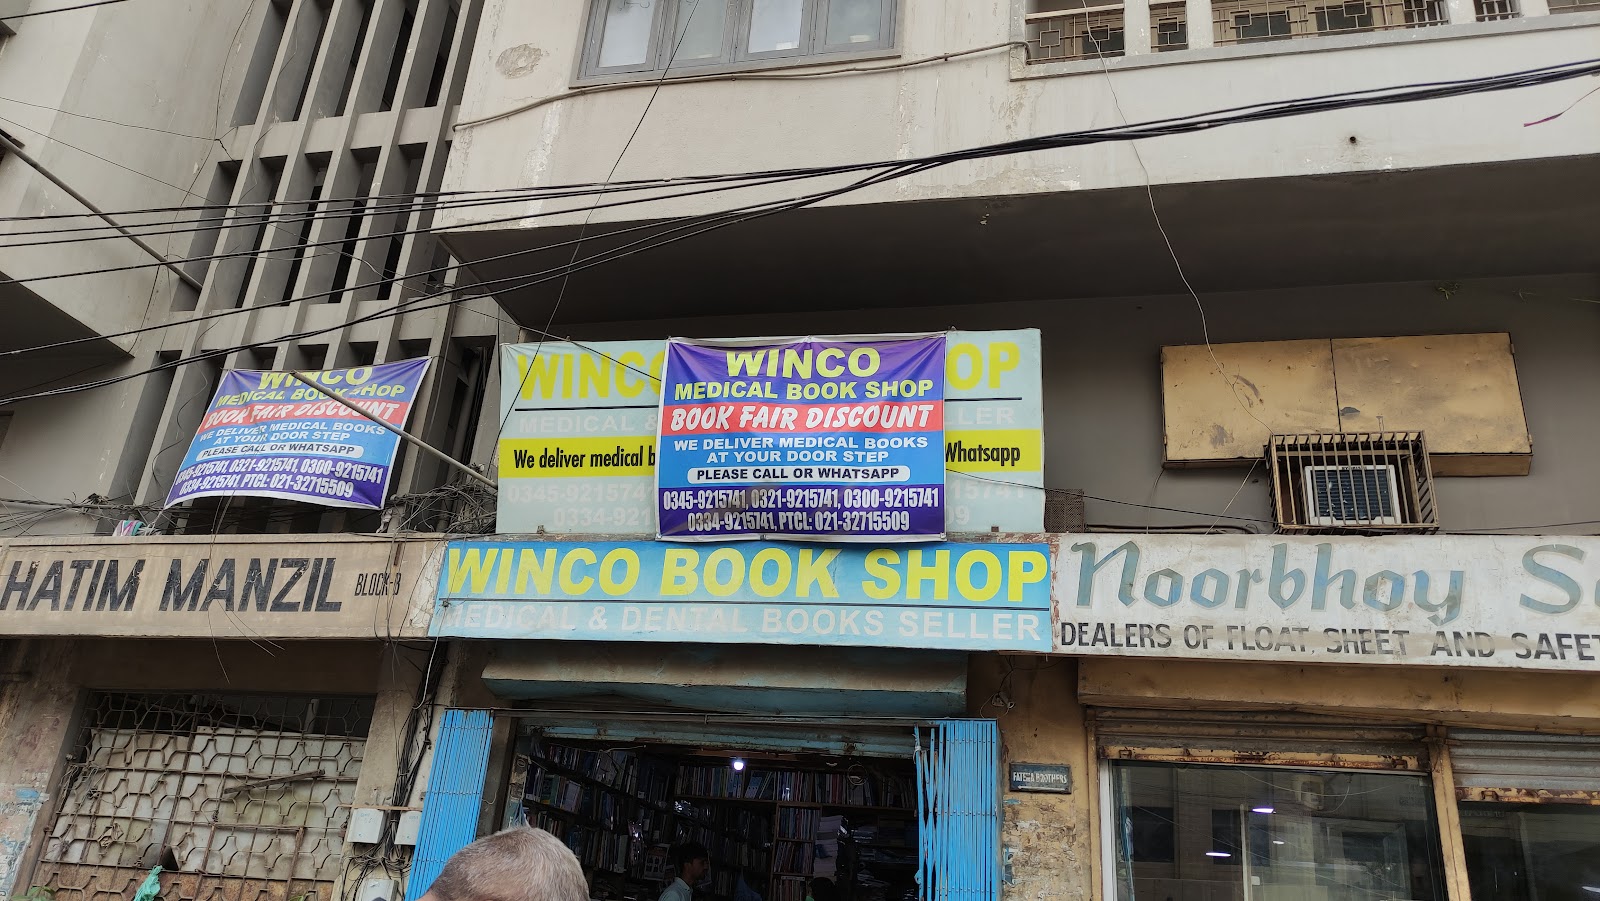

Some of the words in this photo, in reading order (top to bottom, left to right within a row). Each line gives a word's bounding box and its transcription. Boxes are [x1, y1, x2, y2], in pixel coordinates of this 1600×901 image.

[726, 347, 881, 379] WINCO
[945, 342, 1020, 391] OP
[215, 391, 285, 408] MEDICAL
[674, 381, 778, 400] MEDICAL
[786, 381, 857, 401] BOOK
[865, 379, 933, 399] SHOP
[204, 407, 250, 429] BOOK
[250, 404, 295, 422] FAIR
[294, 400, 400, 420] DISCOUNT
[519, 415, 635, 433] MEDICAL
[670, 405, 735, 432] BOOK
[739, 404, 799, 430] FAIR
[805, 404, 934, 429] DISCOUNT
[200, 431, 215, 442] WE
[216, 425, 267, 437] DELIVER
[269, 422, 328, 432] MEDICAL
[332, 422, 386, 435] BOOKS
[213, 436, 231, 445] AT
[234, 433, 268, 443] YOUR
[270, 431, 309, 441] DOOR
[311, 431, 351, 441] STEP
[674, 439, 698, 451] WE
[702, 437, 774, 450] DELIVER
[778, 437, 859, 449] MEDICAL
[864, 437, 929, 449] BOOKS
[201, 446, 239, 457] PLEASE
[240, 444, 266, 453] CALL
[270, 443, 287, 451] OR
[288, 443, 355, 454] WHATSAPP
[514, 449, 535, 468] We
[539, 447, 585, 468] deliver
[590, 445, 644, 467] medical
[945, 440, 1021, 467] Whatsapp
[706, 451, 729, 463] AT
[734, 451, 784, 463] YOUR
[786, 450, 838, 463] DOOR
[843, 451, 889, 463] STEP
[300, 458, 383, 483] 0300-9215741
[697, 468, 748, 480] PLEASE
[752, 468, 789, 480] CALL
[793, 468, 813, 479] OR
[817, 468, 899, 479] WHATSAPP
[240, 473, 271, 488] PTCL:
[269, 473, 354, 498] 021-32715509
[663, 489, 749, 511] 0345-9215741,
[751, 488, 841, 510] 0321-9215741,
[844, 487, 939, 508] 0300-9215741
[687, 511, 777, 532] 0334-9215741,
[778, 511, 813, 531] PTCL:
[814, 510, 910, 531] 021-32715509
[0, 558, 147, 612] HATIM
[158, 557, 343, 612] MANZIL
[447, 547, 641, 597] WINCO
[659, 547, 843, 598] BOOK
[861, 549, 1048, 602] SHOP
[1520, 543, 1600, 616] S
[588, 606, 608, 631] &
[621, 606, 748, 633] DENTAL
[761, 608, 885, 636] BOOKS
[899, 611, 1041, 641] SELLER
[1061, 621, 1173, 649] DEALERS
[1183, 624, 1214, 650] OF
[1323, 628, 1410, 656] SHEET
[1430, 630, 1496, 658] AND
